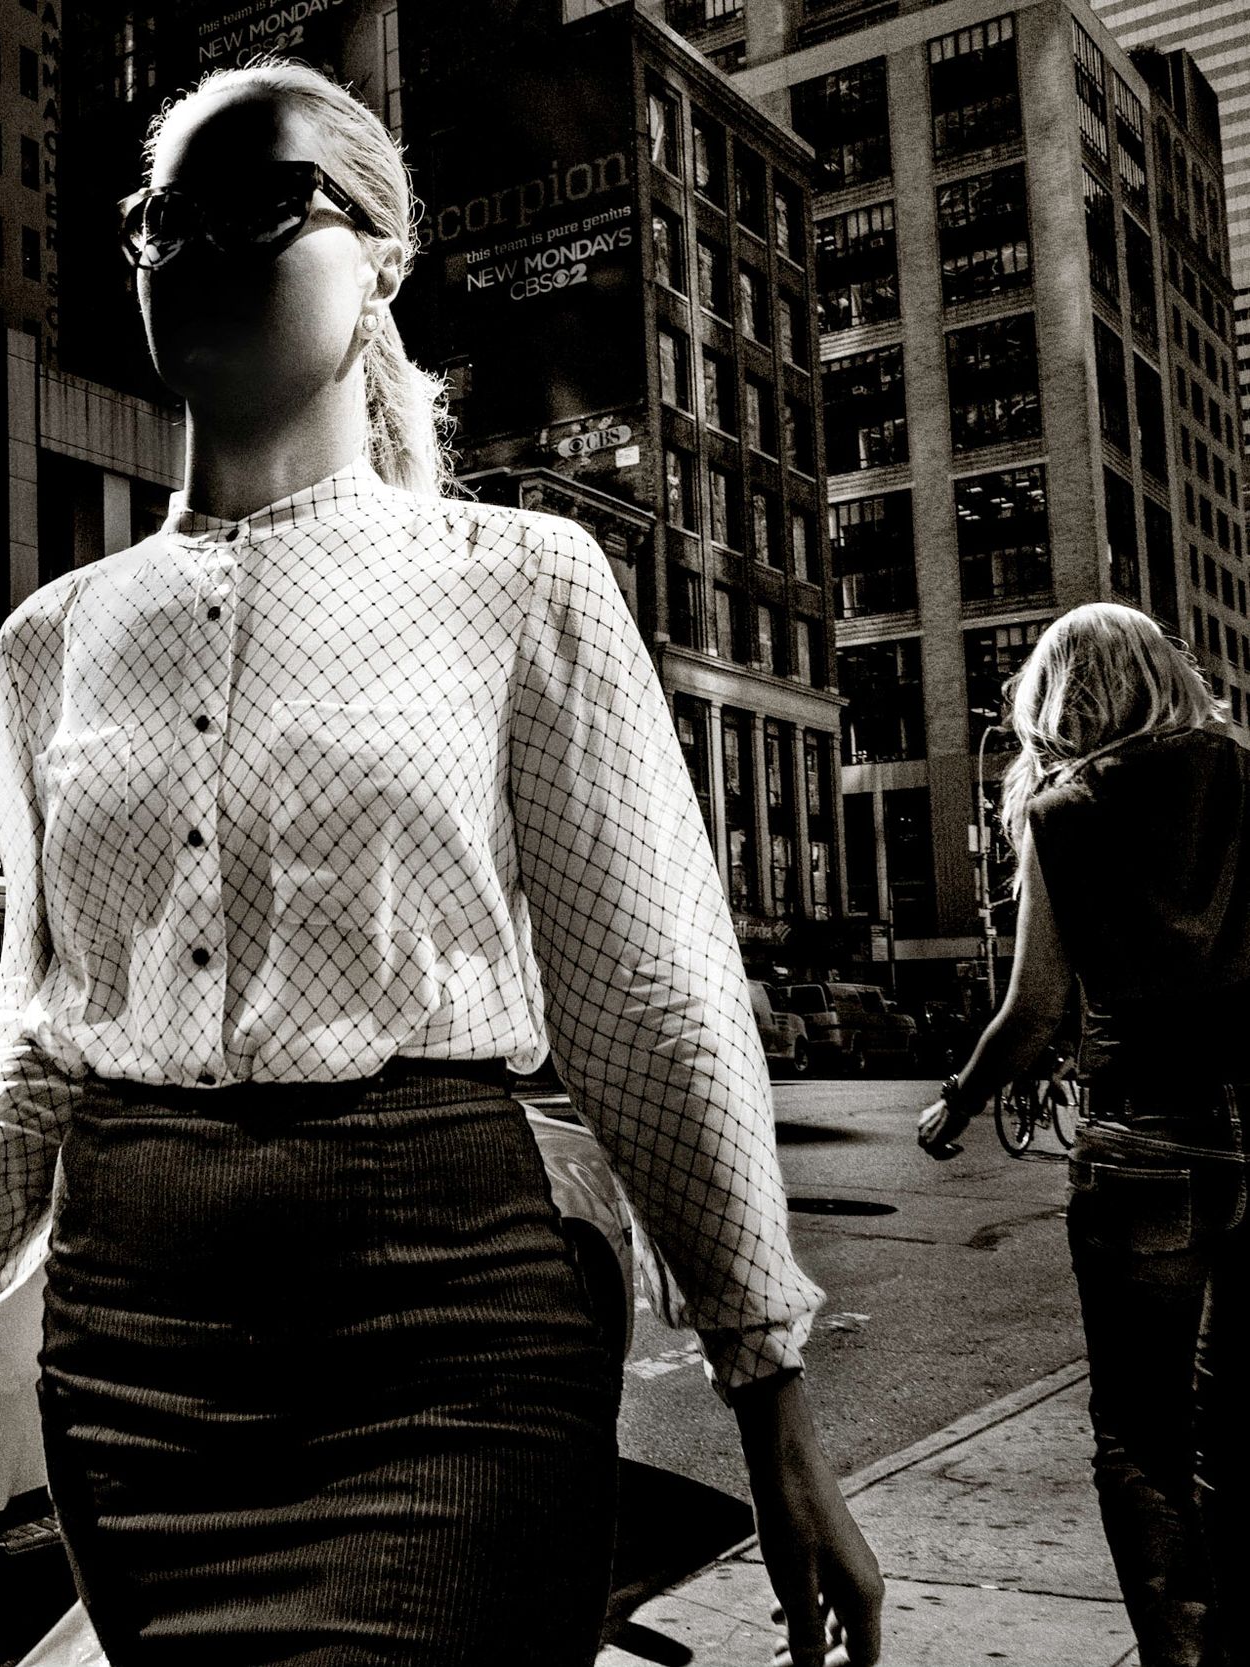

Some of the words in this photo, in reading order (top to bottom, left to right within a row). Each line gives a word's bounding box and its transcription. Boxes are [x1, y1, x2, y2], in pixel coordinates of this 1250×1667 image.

[198, 28, 245, 63] NEW
[248, 0, 344, 42] MONDAY
[466, 247, 492, 265] this
[494, 237, 528, 256] team
[531, 233, 543, 246] is
[546, 221, 579, 243] pure
[582, 205, 632, 232] genius
[466, 259, 519, 293] NEW
[523, 226, 634, 276] MONDAYS
[586, 427, 620, 450] CBS
